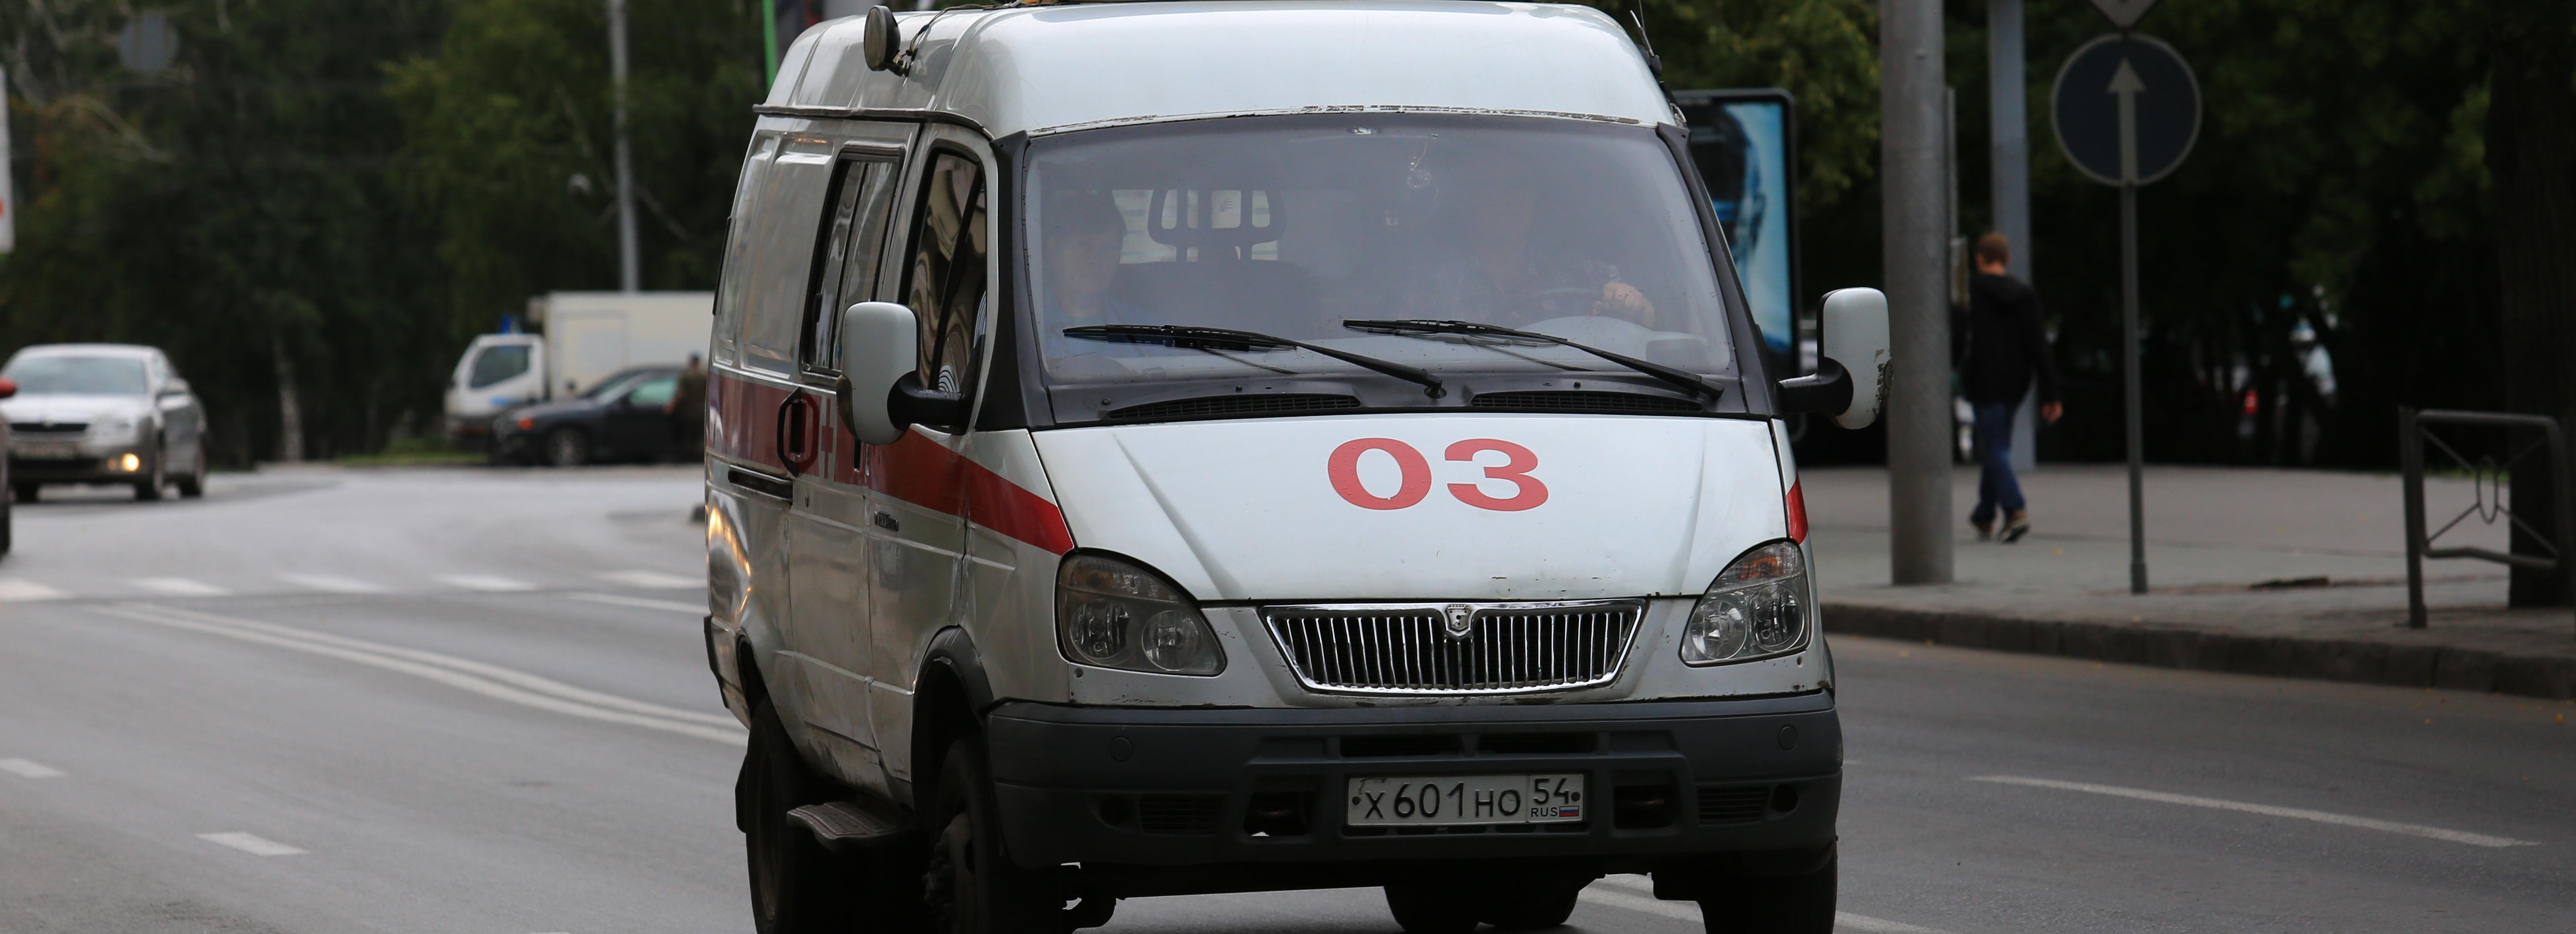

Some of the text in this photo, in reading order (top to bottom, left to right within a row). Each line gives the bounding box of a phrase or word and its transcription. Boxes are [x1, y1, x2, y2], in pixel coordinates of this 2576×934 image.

[1328, 438, 1549, 511] 03
[1534, 778, 1570, 804] 54
[1531, 807, 1558, 817] RUS
